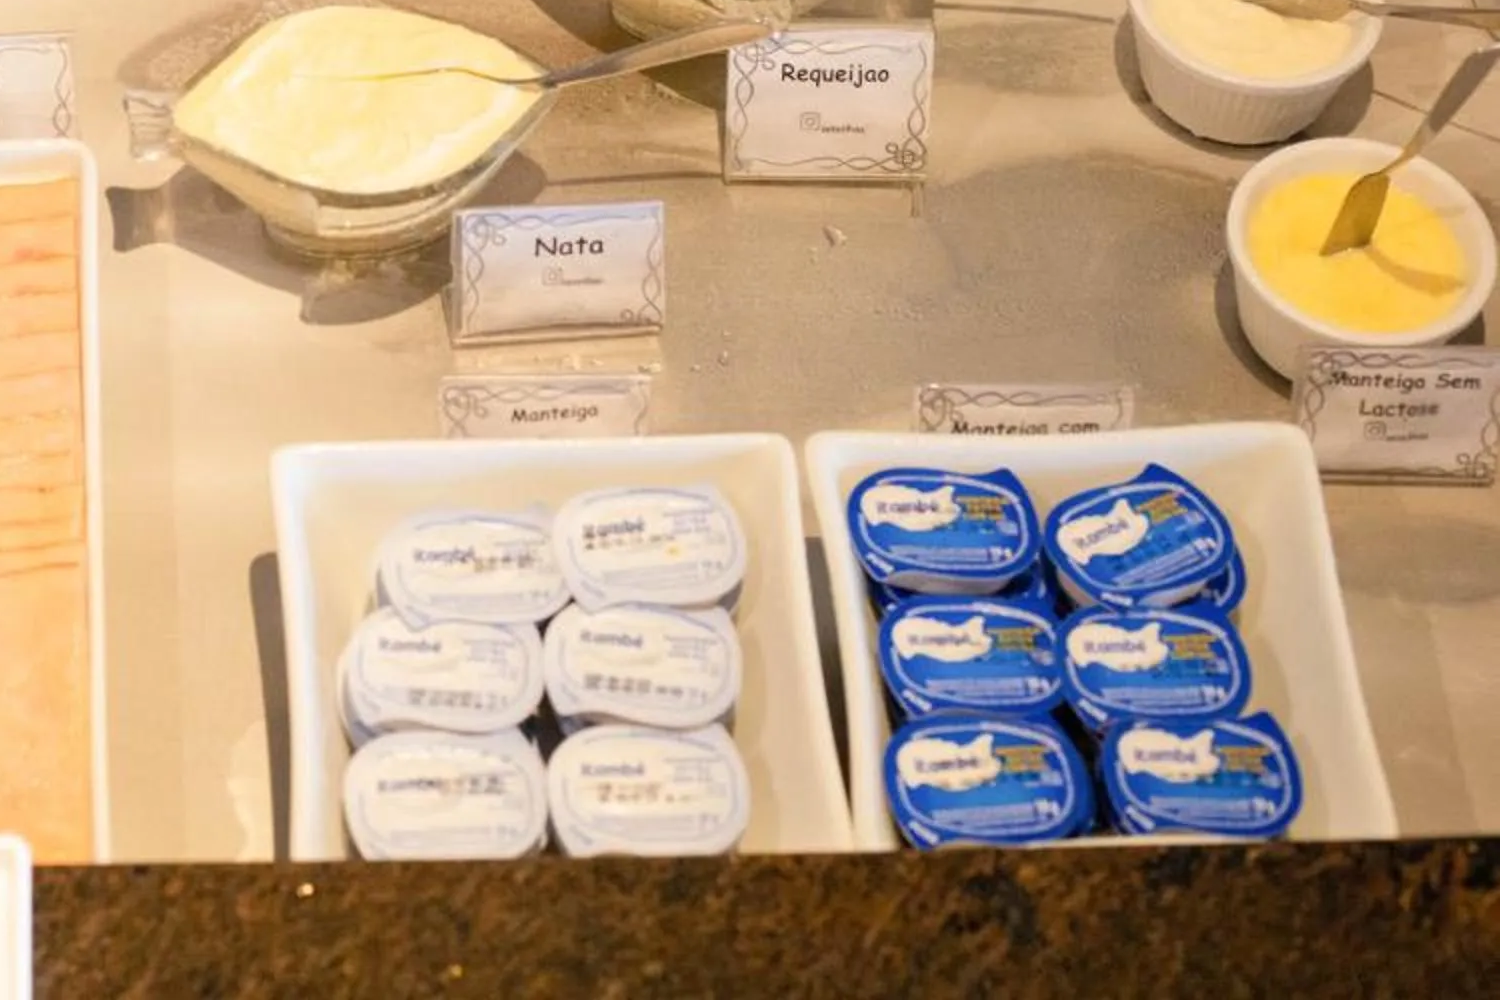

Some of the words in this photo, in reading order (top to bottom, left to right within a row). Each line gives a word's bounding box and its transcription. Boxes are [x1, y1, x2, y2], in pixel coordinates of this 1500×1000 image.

[780, 62, 890, 88] Requeijao
[534, 236, 605, 257] Nata
[1328, 371, 1426, 395] Manteiga
[1434, 373, 1482, 390] Sem
[511, 405, 599, 425] Manteiga
[1358, 399, 1441, 418] Lactose
